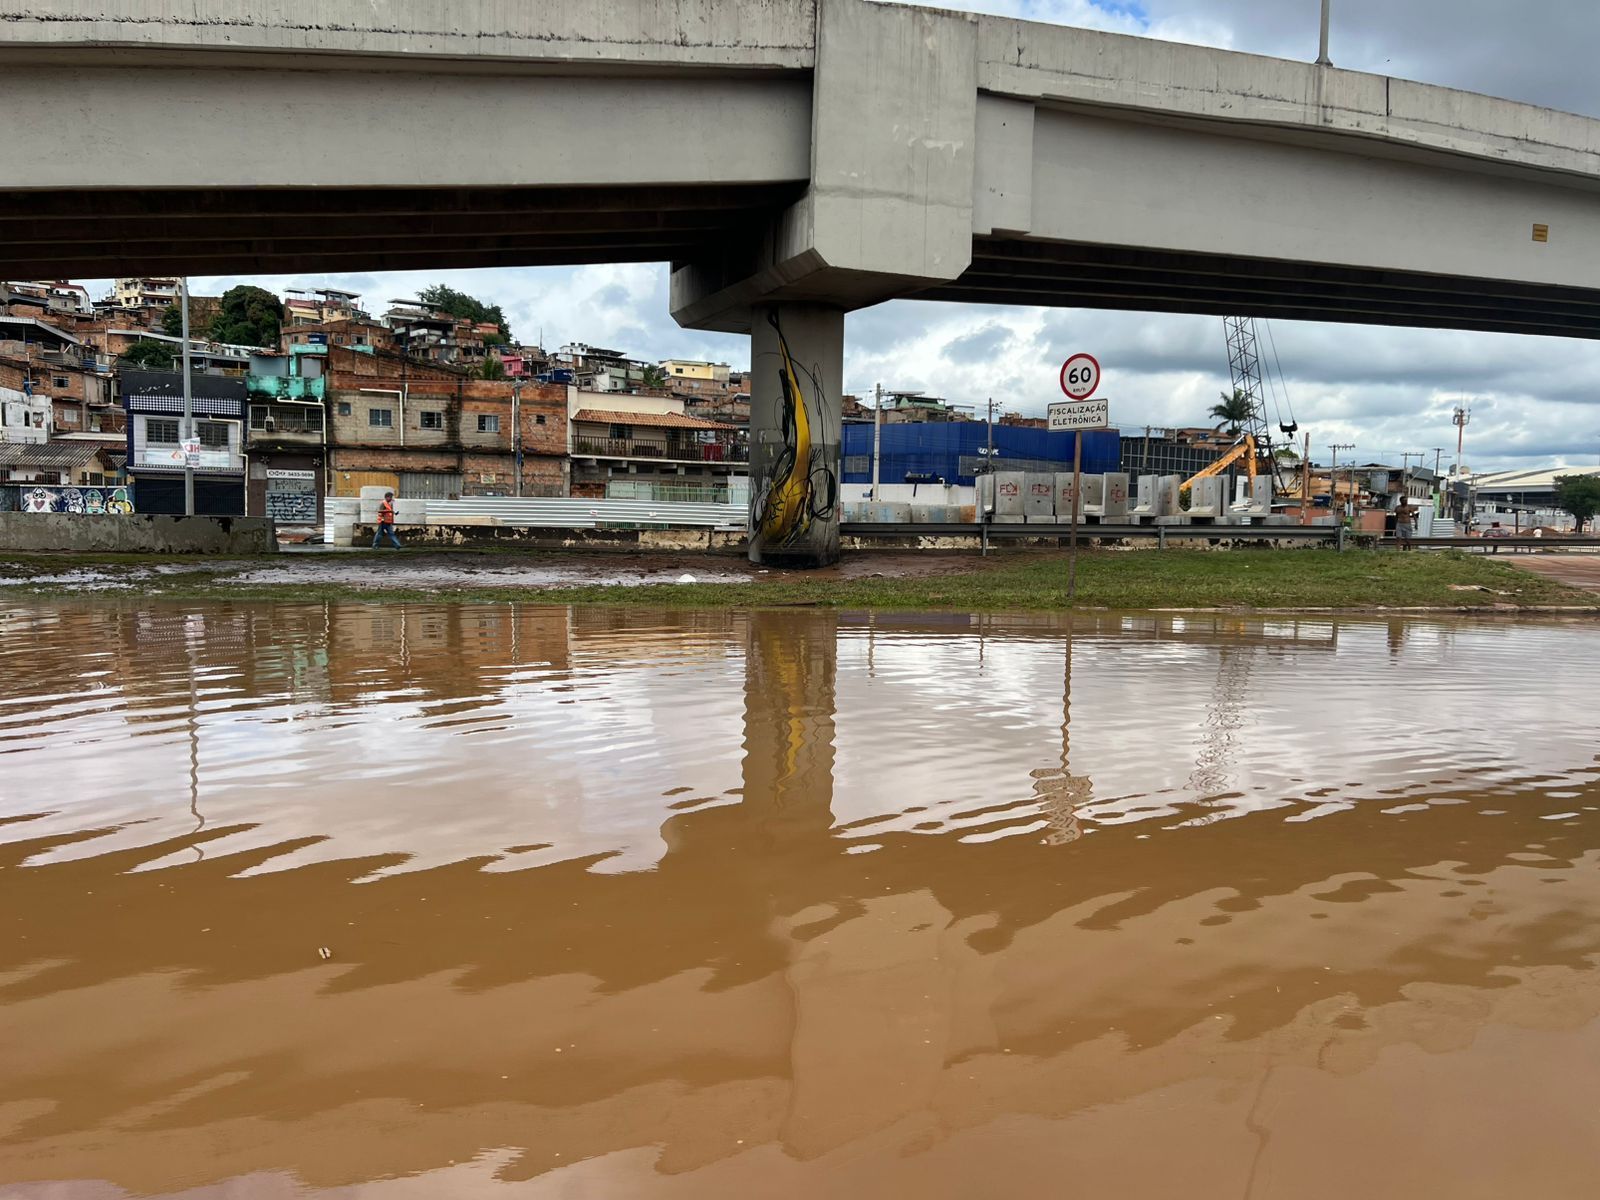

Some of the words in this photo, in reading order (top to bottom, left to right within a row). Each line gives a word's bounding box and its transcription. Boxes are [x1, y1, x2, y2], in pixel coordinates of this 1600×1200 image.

[1068, 366, 1092, 384] 60
[1049, 403, 1107, 416] FISCALIZAÇÃO
[1052, 414, 1102, 426] ELETRÔNICA
